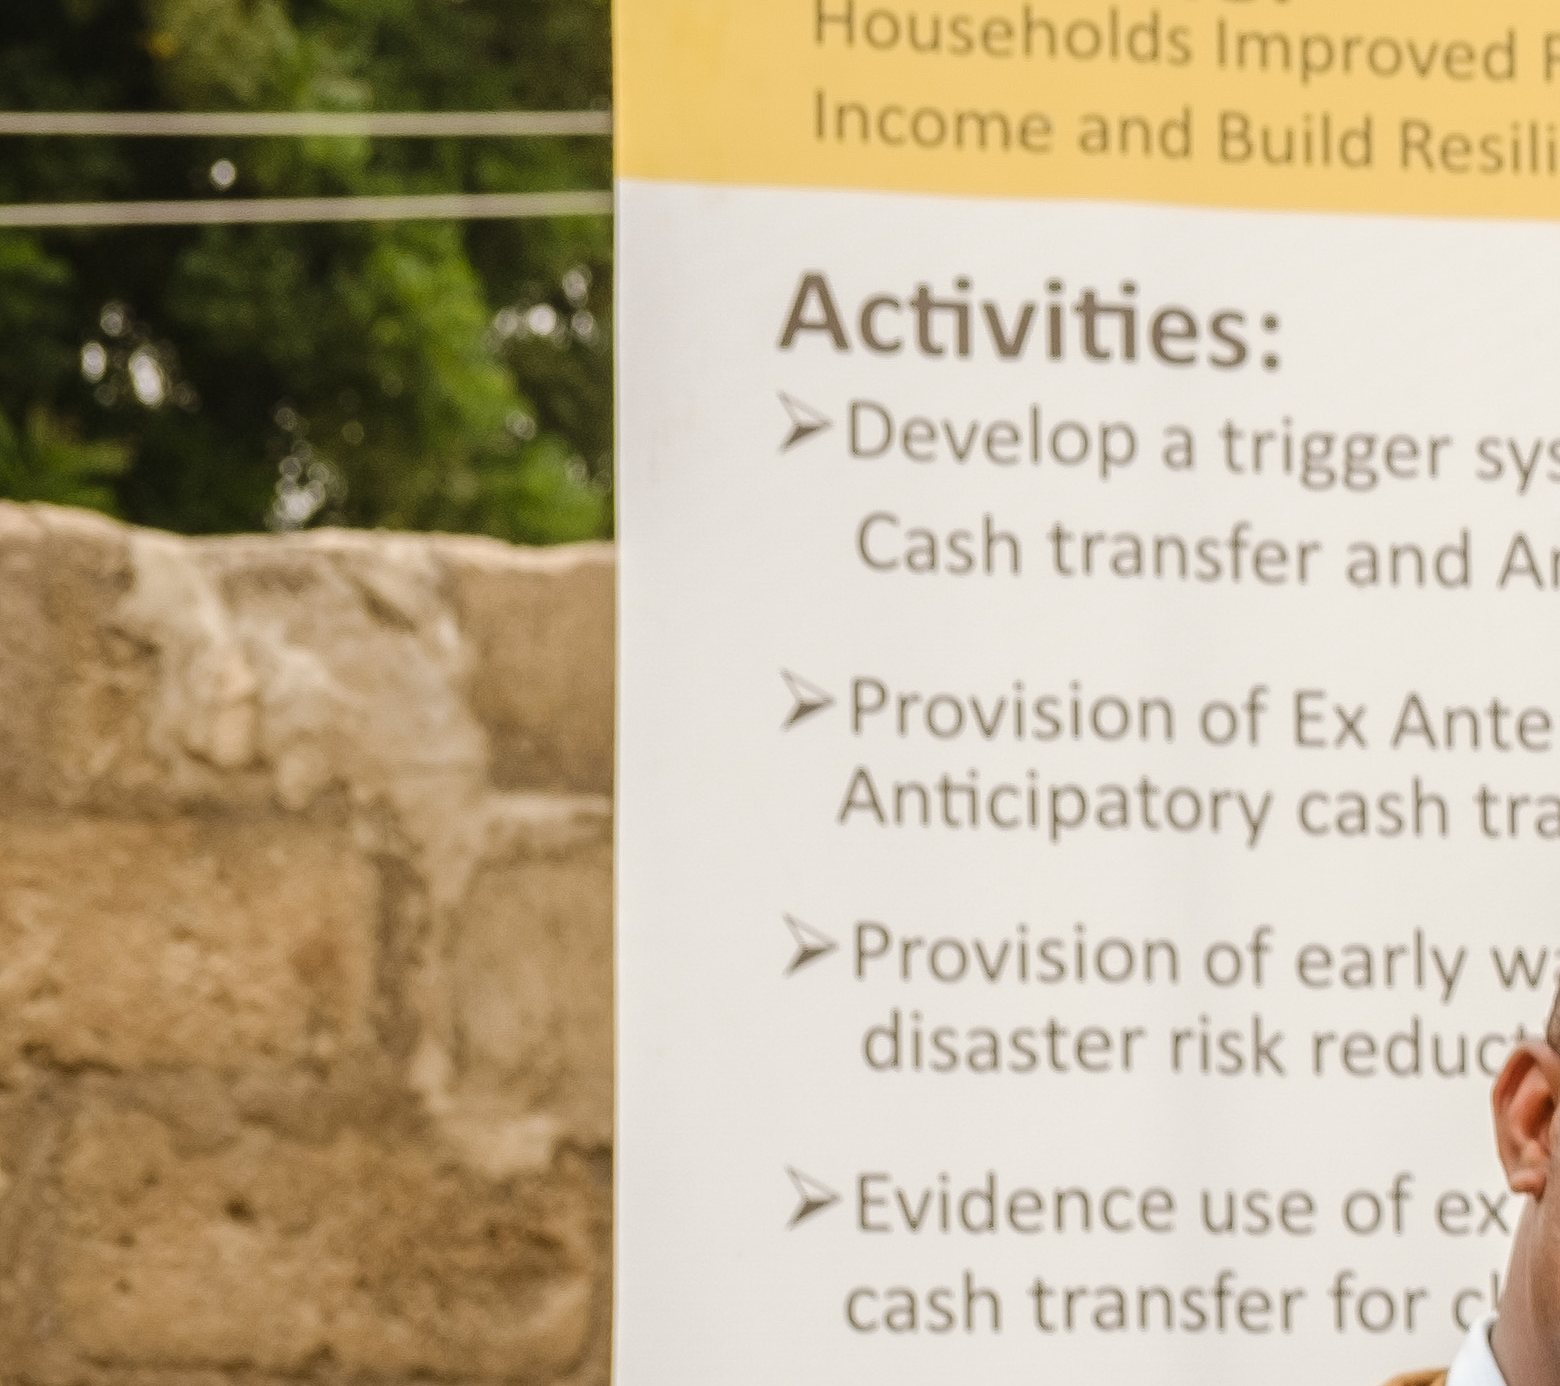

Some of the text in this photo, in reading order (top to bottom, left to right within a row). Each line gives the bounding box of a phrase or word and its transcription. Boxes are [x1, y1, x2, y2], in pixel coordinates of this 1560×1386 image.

[1217, 17, 1517, 86] Improved
[814, 88, 1053, 154] Income
[1078, 106, 1193, 160] and
[1218, 110, 1373, 169] Build
[778, 271, 1279, 370] Activities:
[848, 399, 1138, 480] Develop
[1162, 425, 1195, 471] a
[1220, 416, 1452, 492] trigger
[856, 511, 1021, 575] Cash
[1048, 521, 1321, 585] transfer
[1346, 528, 1471, 589] and
[851, 676, 1174, 742] Provision
[1199, 685, 1268, 746] of
[1294, 689, 1367, 748] Ex
[1391, 692, 1553, 752] Ante
[837, 766, 1273, 849] Anticipatory
[1297, 776, 1449, 837] cash
[854, 921, 1179, 984] Provision
[1204, 925, 1272, 987] of
[1295, 927, 1467, 1005] early
[862, 1008, 1536, 1080] disaster risk reduc
[857, 1171, 1176, 1234] Evidence
[1201, 1190, 1316, 1236] use
[1342, 1172, 1413, 1236] of
[844, 1270, 1001, 1334] cash
[1029, 1269, 1305, 1334] transfer
[1330, 1270, 1428, 1334] for
